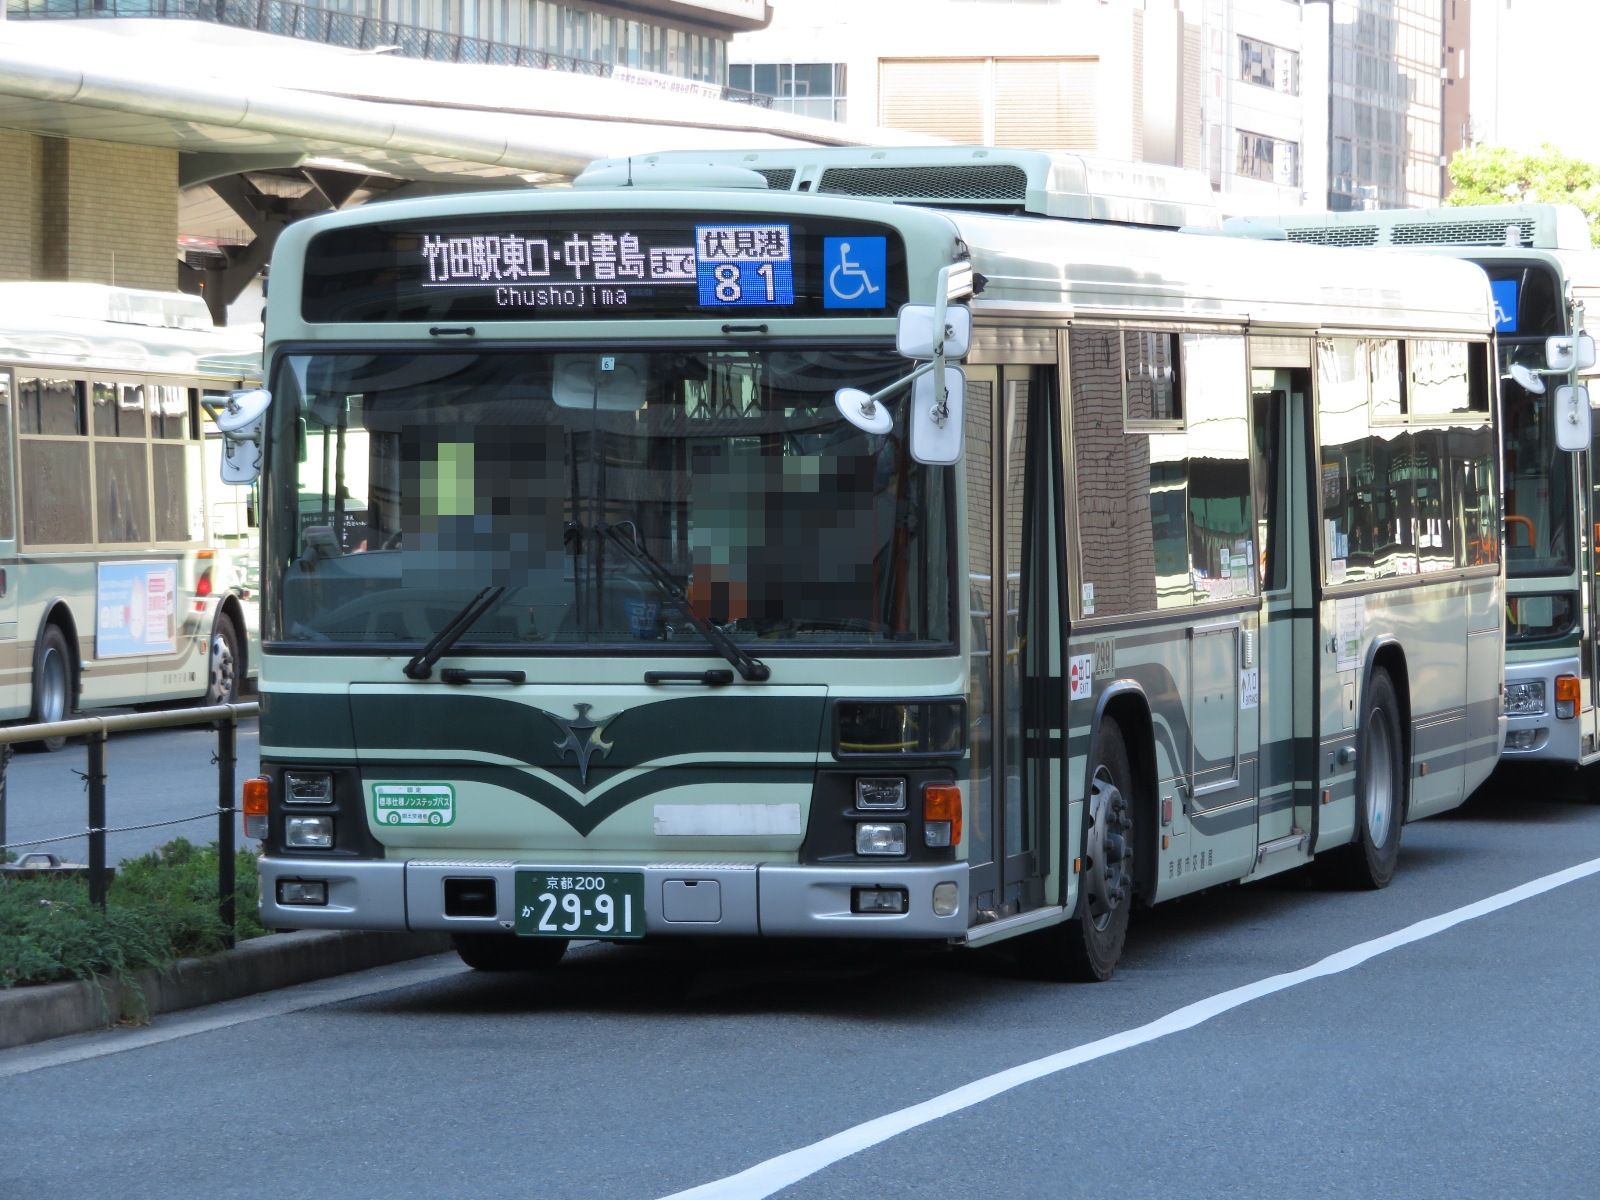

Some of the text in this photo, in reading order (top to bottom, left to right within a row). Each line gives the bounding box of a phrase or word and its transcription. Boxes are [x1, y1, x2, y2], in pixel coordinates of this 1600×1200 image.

[704, 230, 785, 258] 伏見港
[496, 287, 627, 307] Chushojima
[1079, 659, 1090, 681] 出口
[1094, 640, 1114, 675] 2991
[521, 893, 632, 933] か 29-91
